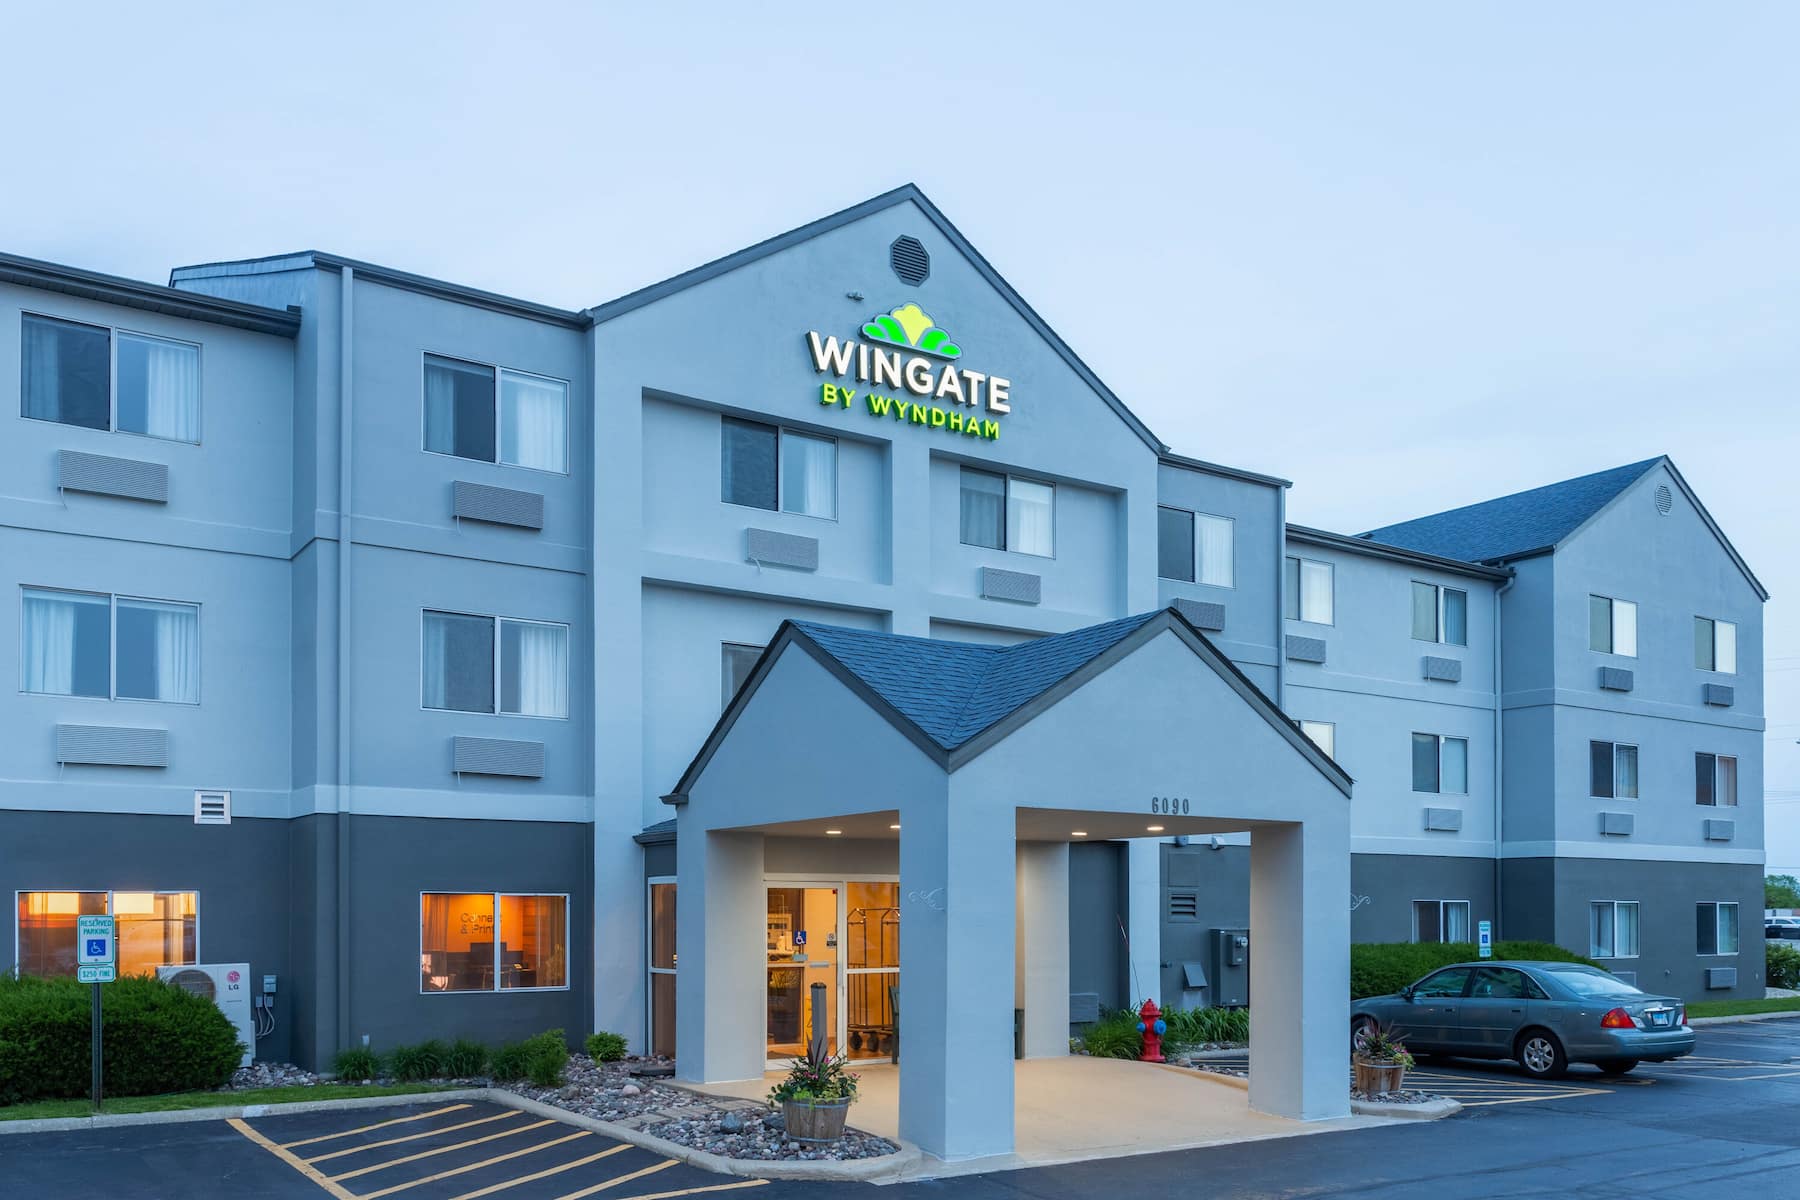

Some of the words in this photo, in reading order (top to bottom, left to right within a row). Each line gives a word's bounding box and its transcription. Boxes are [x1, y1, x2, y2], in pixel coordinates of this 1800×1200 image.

[806, 330, 1010, 414] WINGATE
[820, 383, 856, 409] BY
[865, 392, 1000, 441] WYNDHAM
[1152, 796, 1190, 815] 6090
[80, 919, 112, 927] RESERVED
[461, 924, 468, 934] &
[82, 970, 97, 978] $250
[99, 969, 110, 977] FINE
